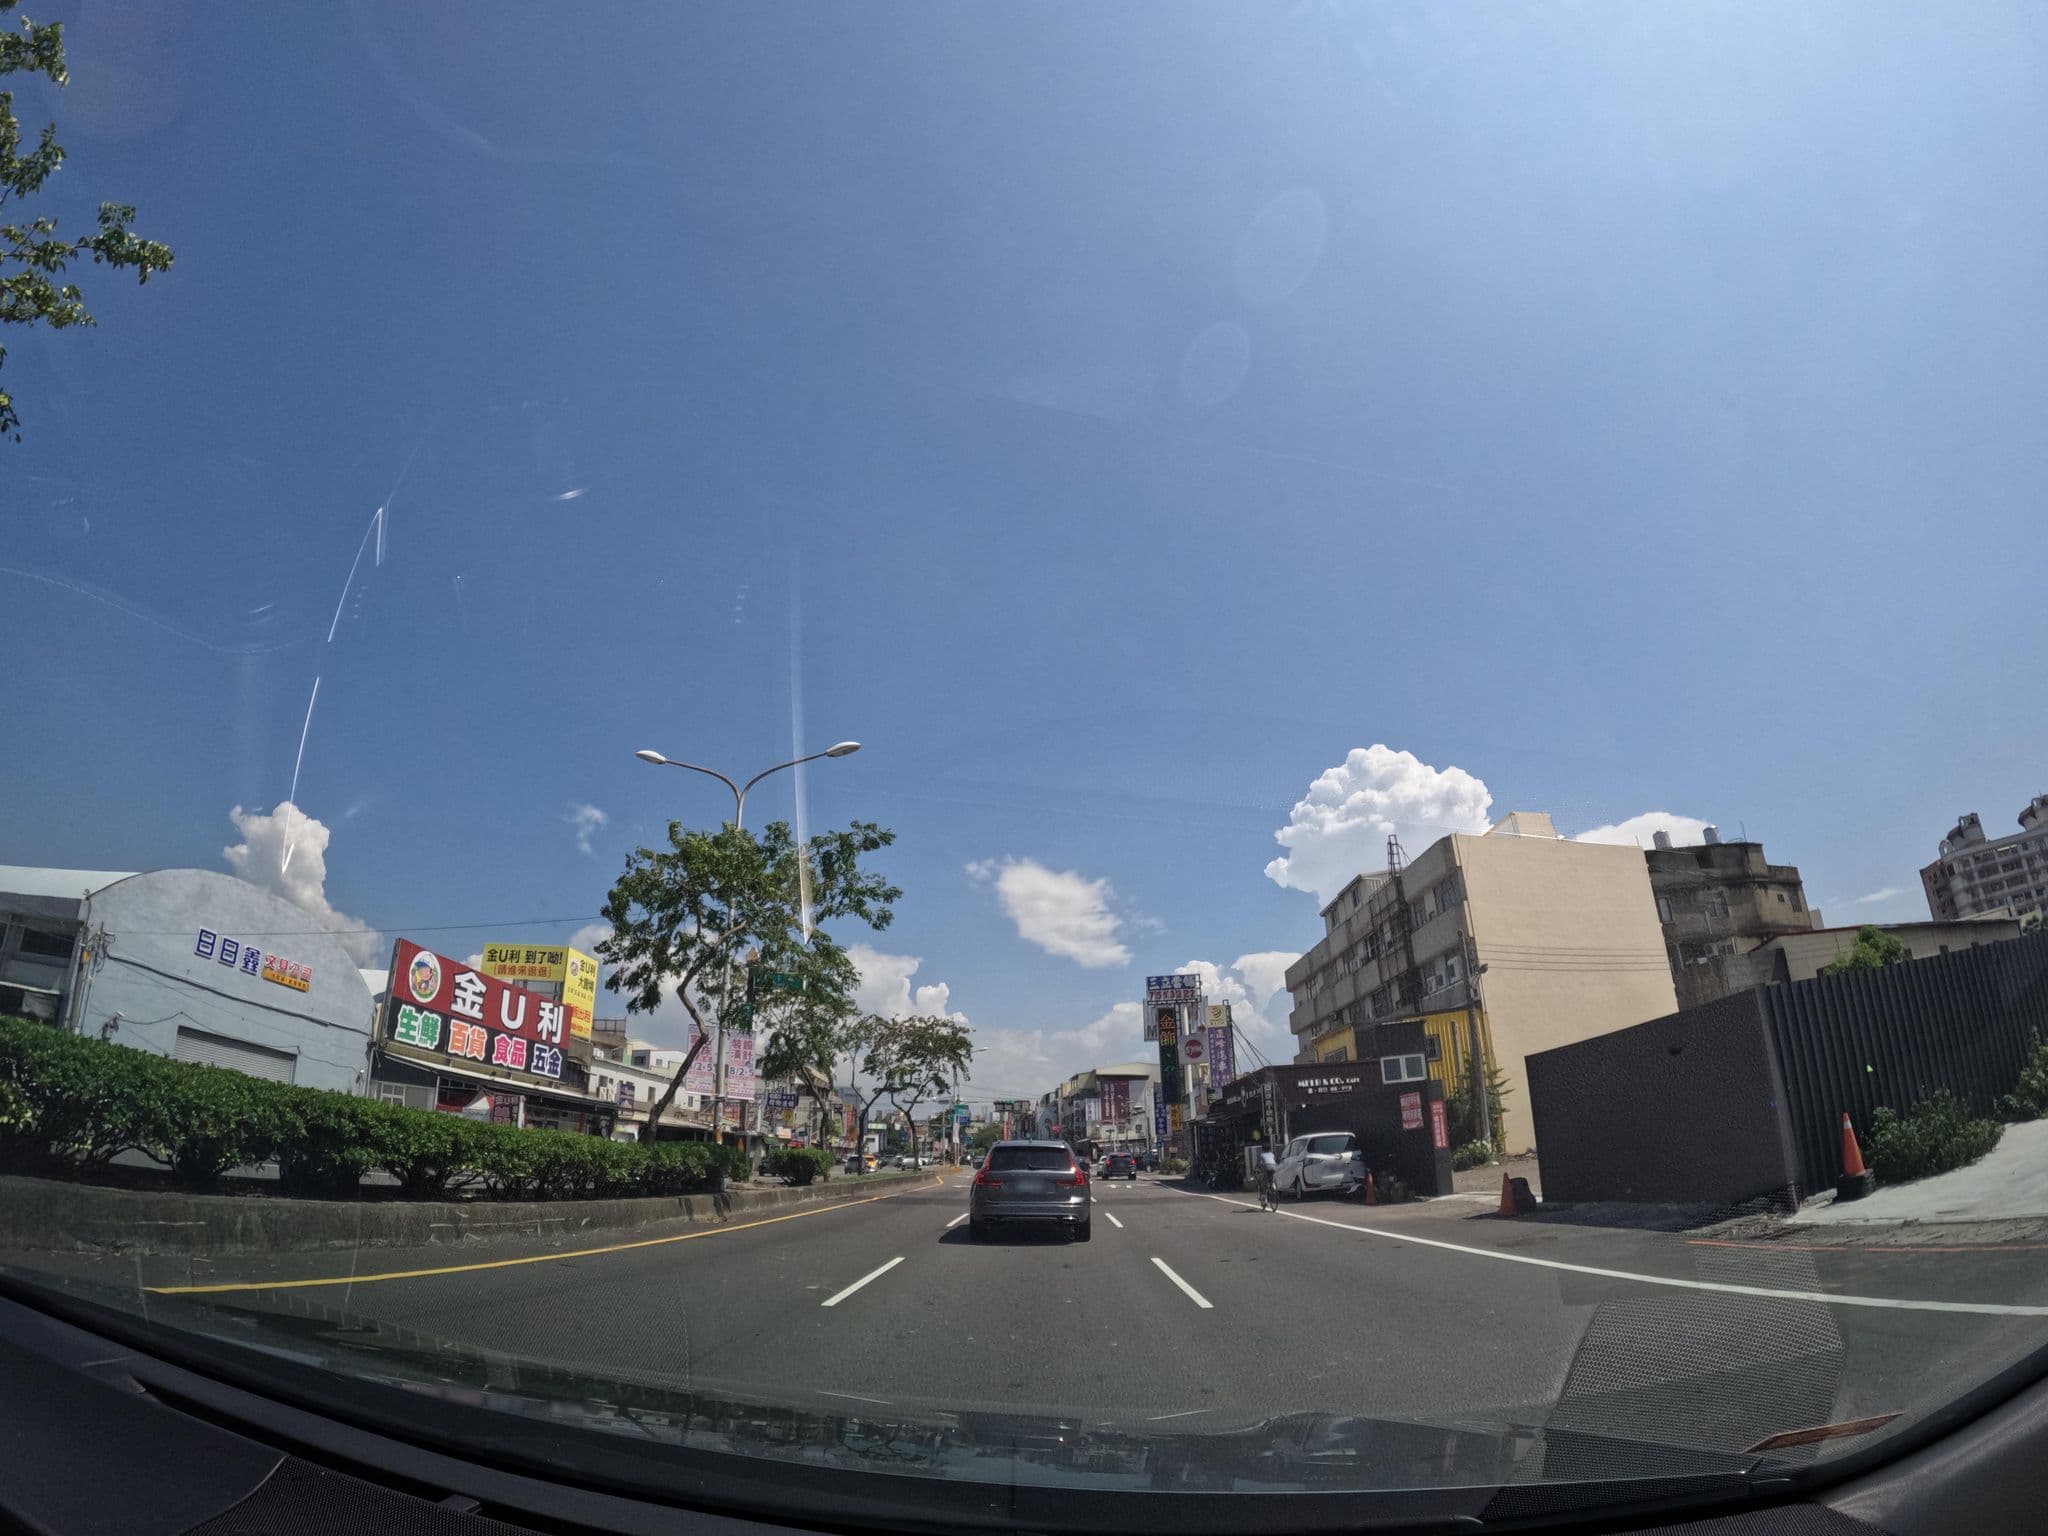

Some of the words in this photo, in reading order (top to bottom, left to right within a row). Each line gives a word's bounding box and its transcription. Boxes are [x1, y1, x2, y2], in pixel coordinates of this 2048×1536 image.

[195, 927, 261, 976] 日日鑫
[487, 948, 519, 963] 金U利
[450, 970, 564, 1045] 金U利
[1160, 1013, 1176, 1047] 金飾
[395, 1004, 441, 1050] 生鮮
[448, 1019, 487, 1061] 百貨
[492, 1034, 527, 1070] 食品
[531, 1043, 562, 1079] 五金
